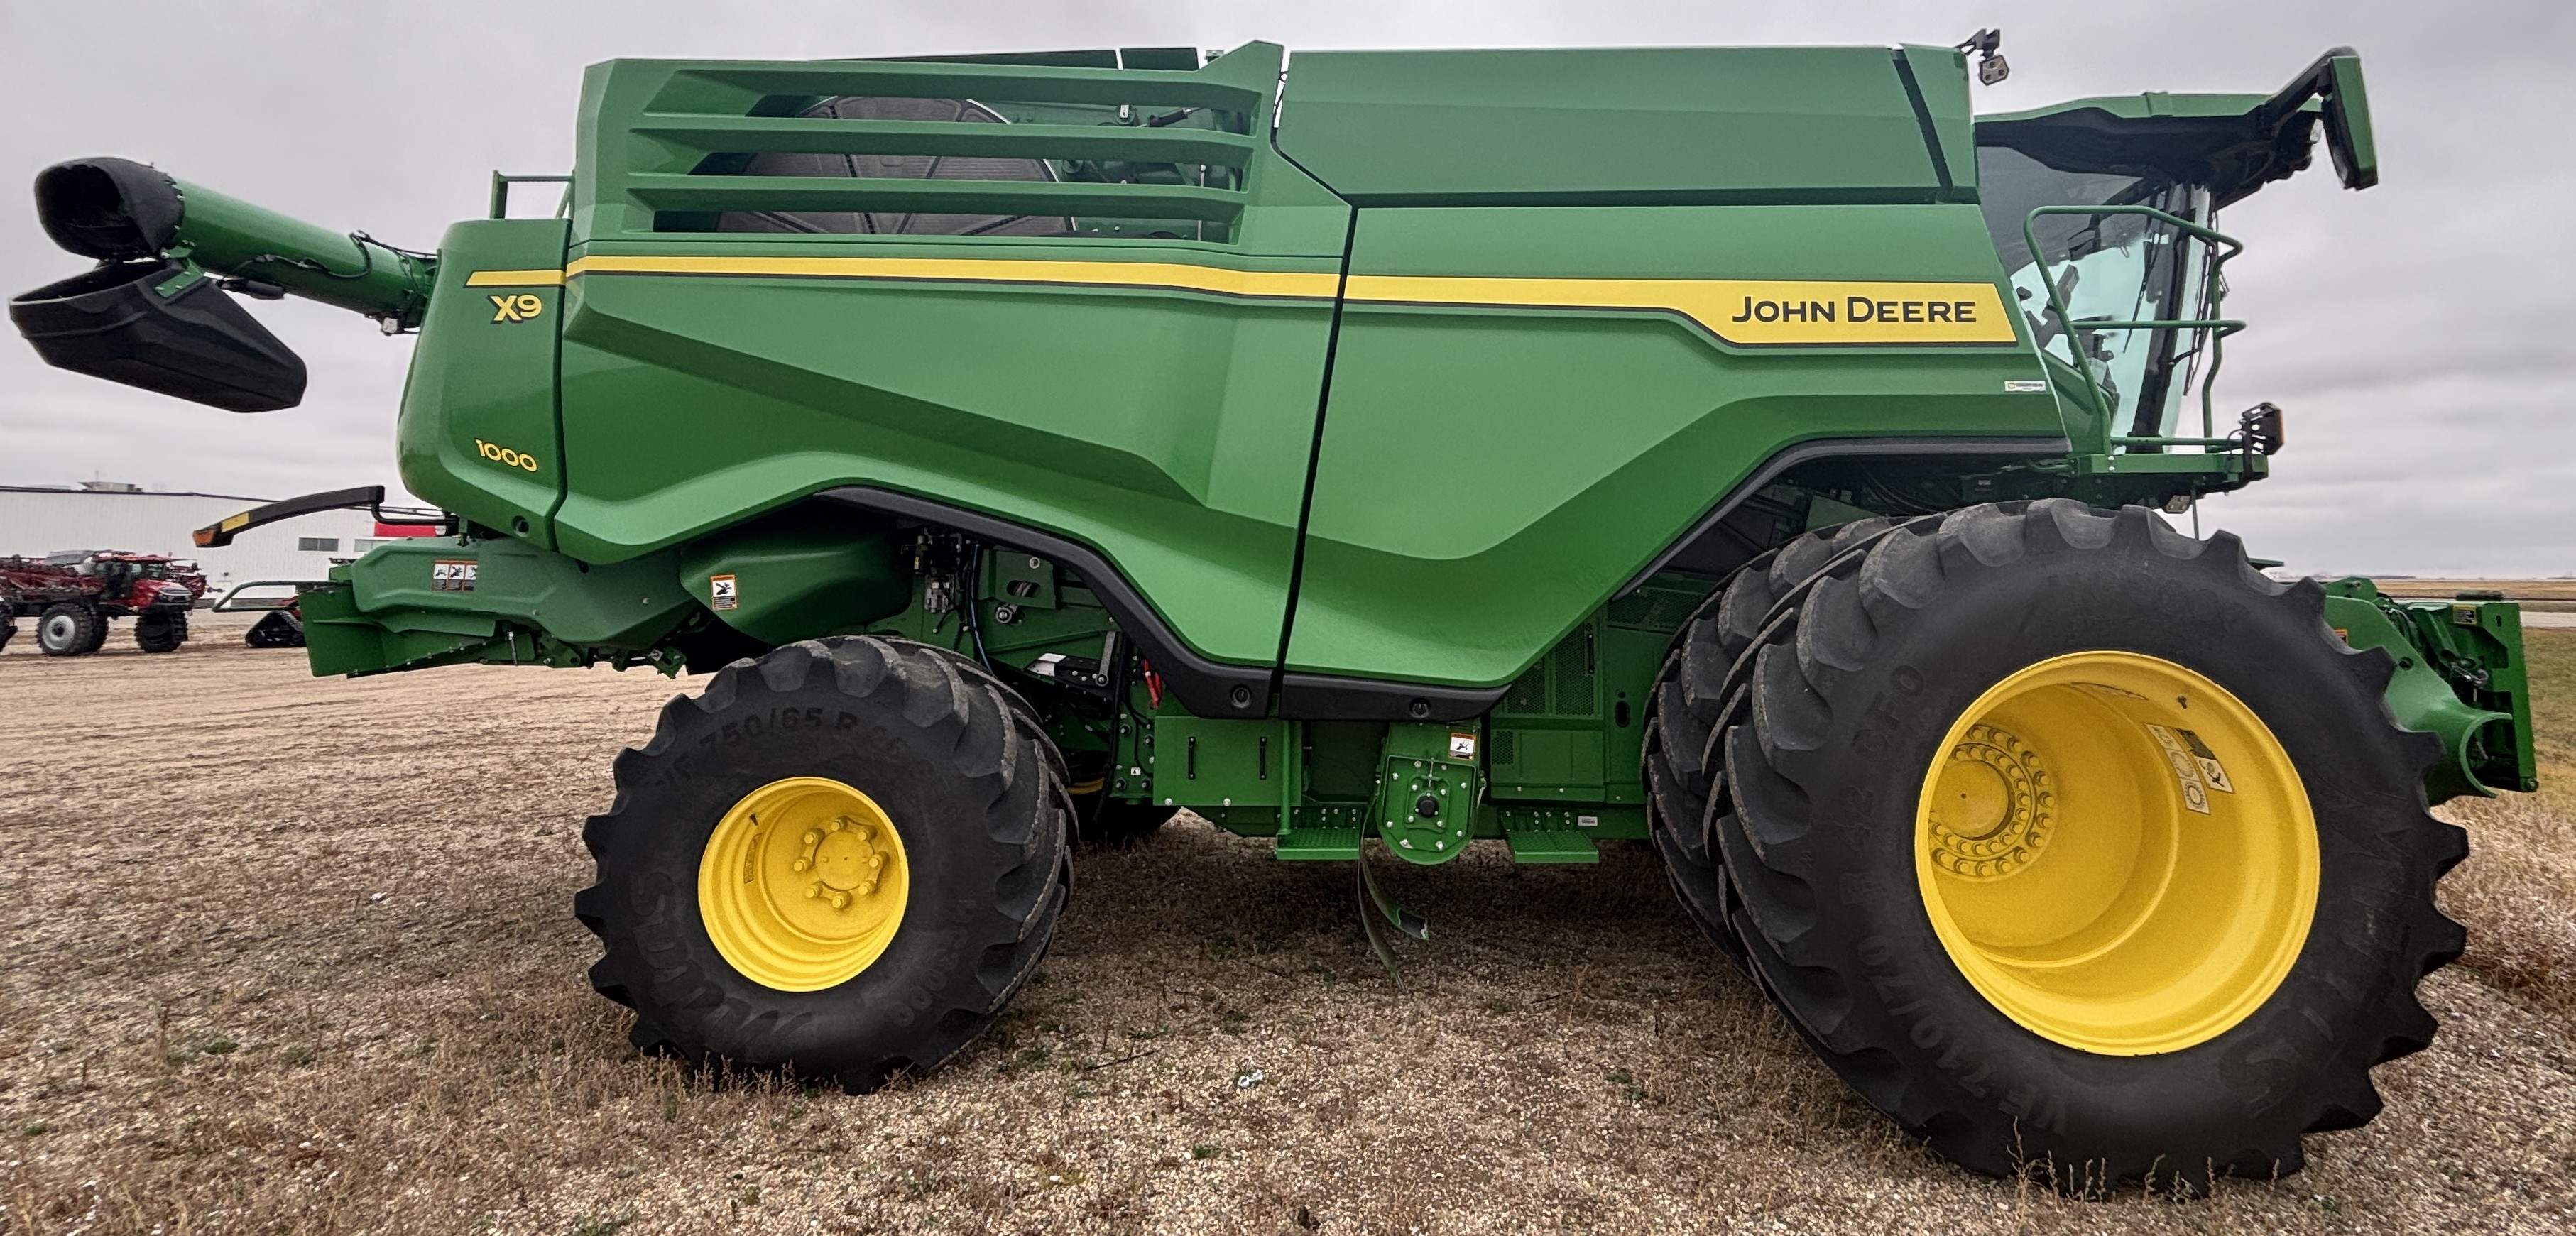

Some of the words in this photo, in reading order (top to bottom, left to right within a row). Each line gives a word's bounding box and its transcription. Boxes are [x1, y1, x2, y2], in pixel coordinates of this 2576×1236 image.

[486, 294, 542, 324] X9
[1732, 296, 1835, 322] JOHN
[1847, 296, 1977, 322] DEERE
[474, 438, 538, 472] 1000
[698, 706, 824, 753] 750/65
[1852, 664, 1924, 758] CFO
[1857, 936, 1997, 1098] 710/70
